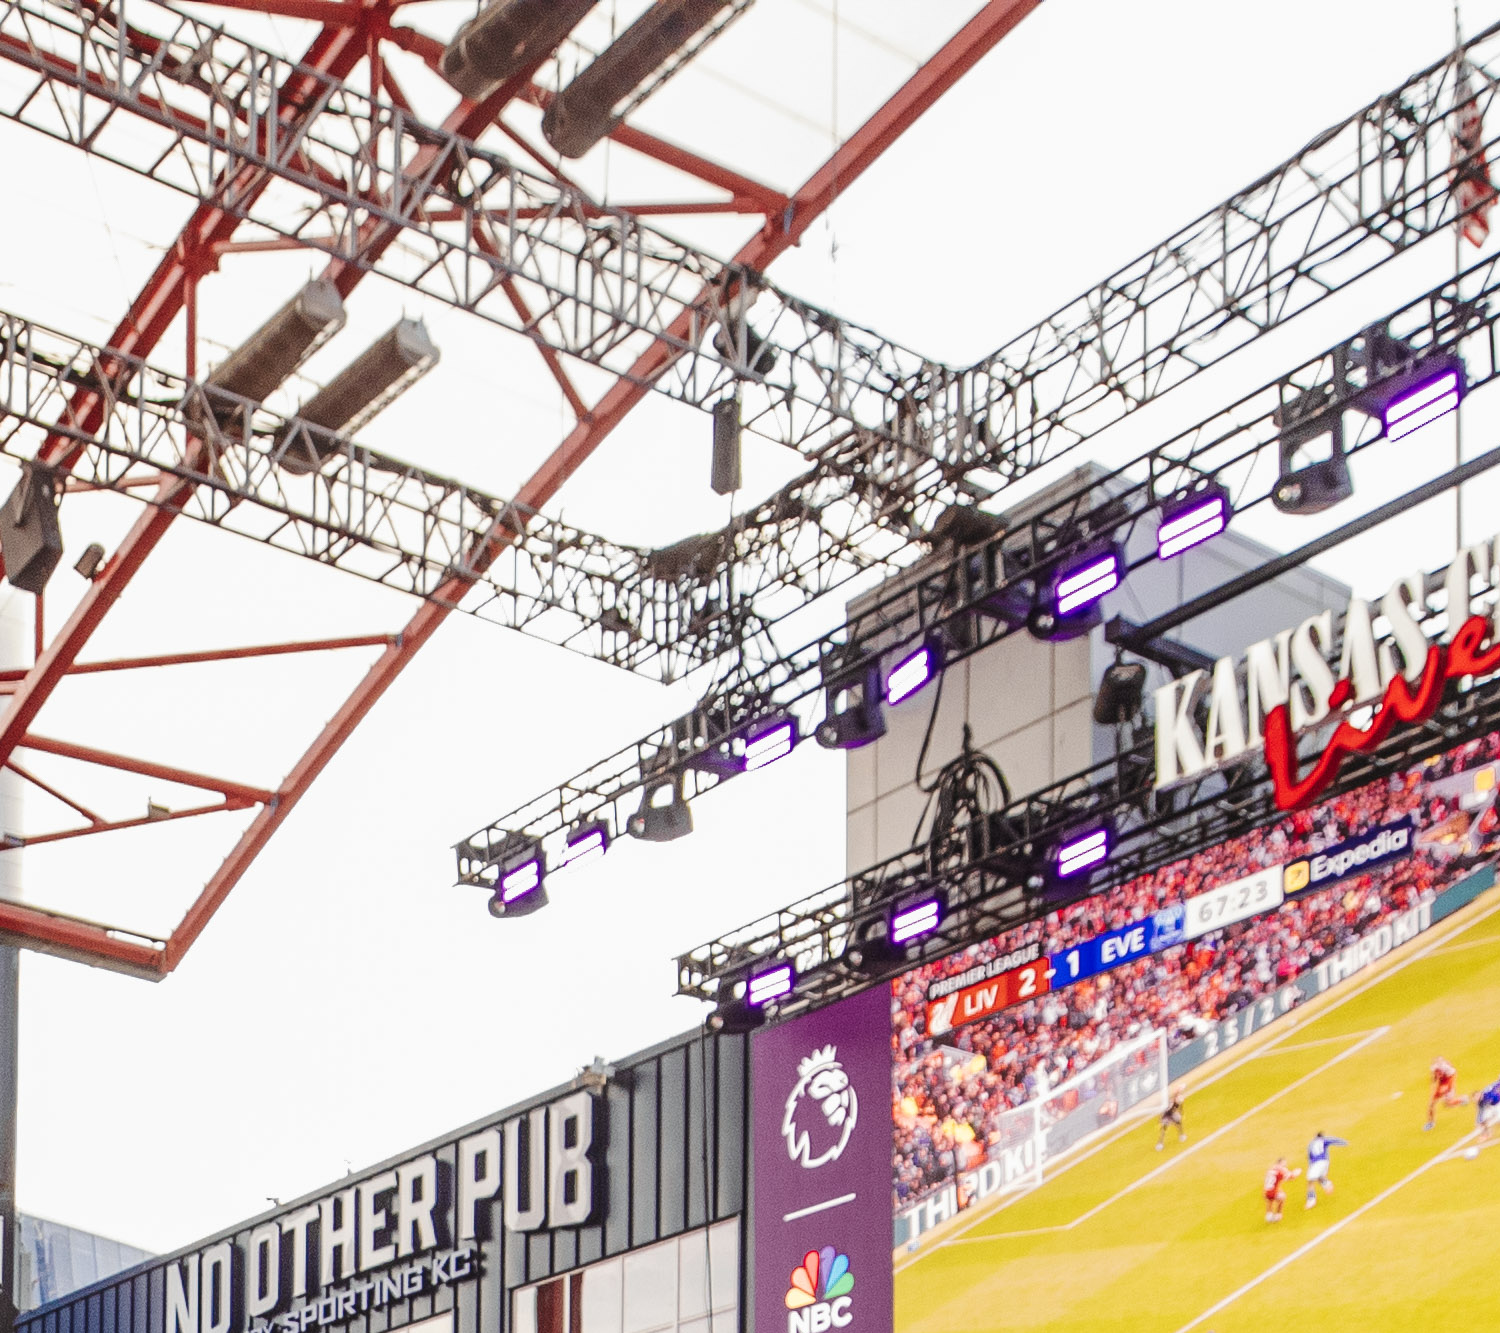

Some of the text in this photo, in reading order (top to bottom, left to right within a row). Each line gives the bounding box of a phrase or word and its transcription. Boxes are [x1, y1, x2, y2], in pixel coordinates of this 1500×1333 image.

[1153, 572, 1432, 792] KANSAS
[1308, 828, 1409, 881] Expedia
[1200, 879, 1270, 925] 67:23
[929, 942, 1041, 998] PREMIER LEAGUE
[962, 985, 1000, 1017] LIV
[1018, 968, 1038, 998] 2
[1067, 950, 1082, 978] 1
[1101, 927, 1147, 966] EVE
[248, 1152, 439, 1320] OTHER
[458, 1090, 595, 1242] PUB
[430, 1247, 475, 1286] KC
